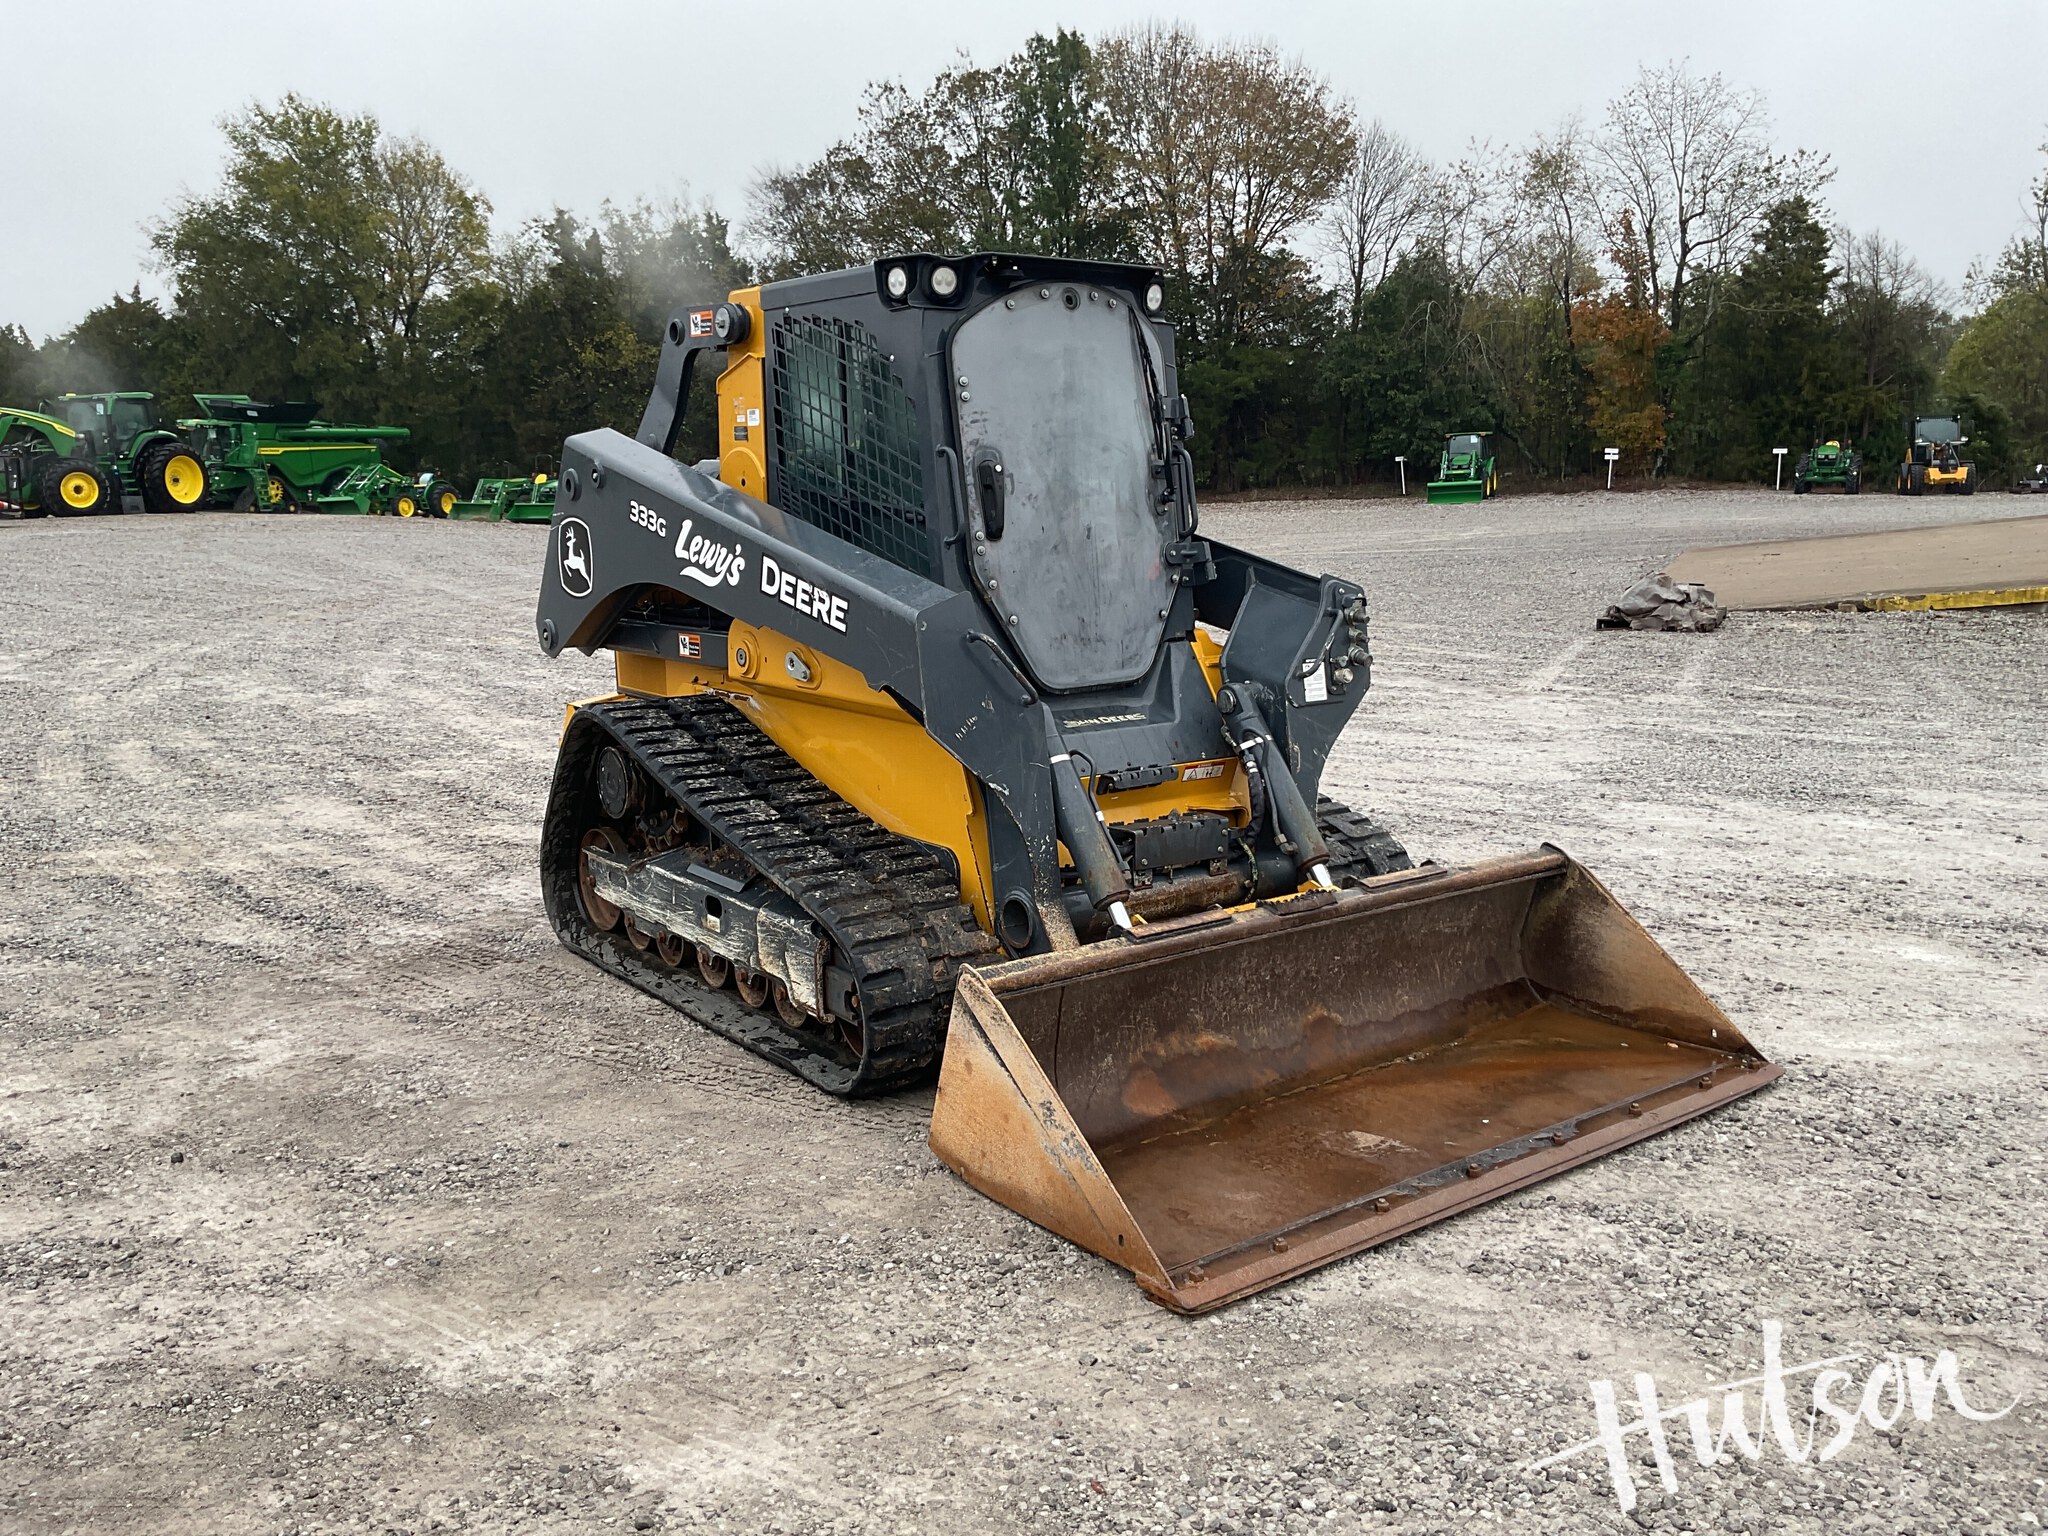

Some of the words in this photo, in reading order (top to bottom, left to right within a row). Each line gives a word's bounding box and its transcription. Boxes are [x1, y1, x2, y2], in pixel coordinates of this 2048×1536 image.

[629, 500, 667, 537] 333G
[675, 519, 745, 587] Lewy's
[761, 555, 848, 633] DEERE
